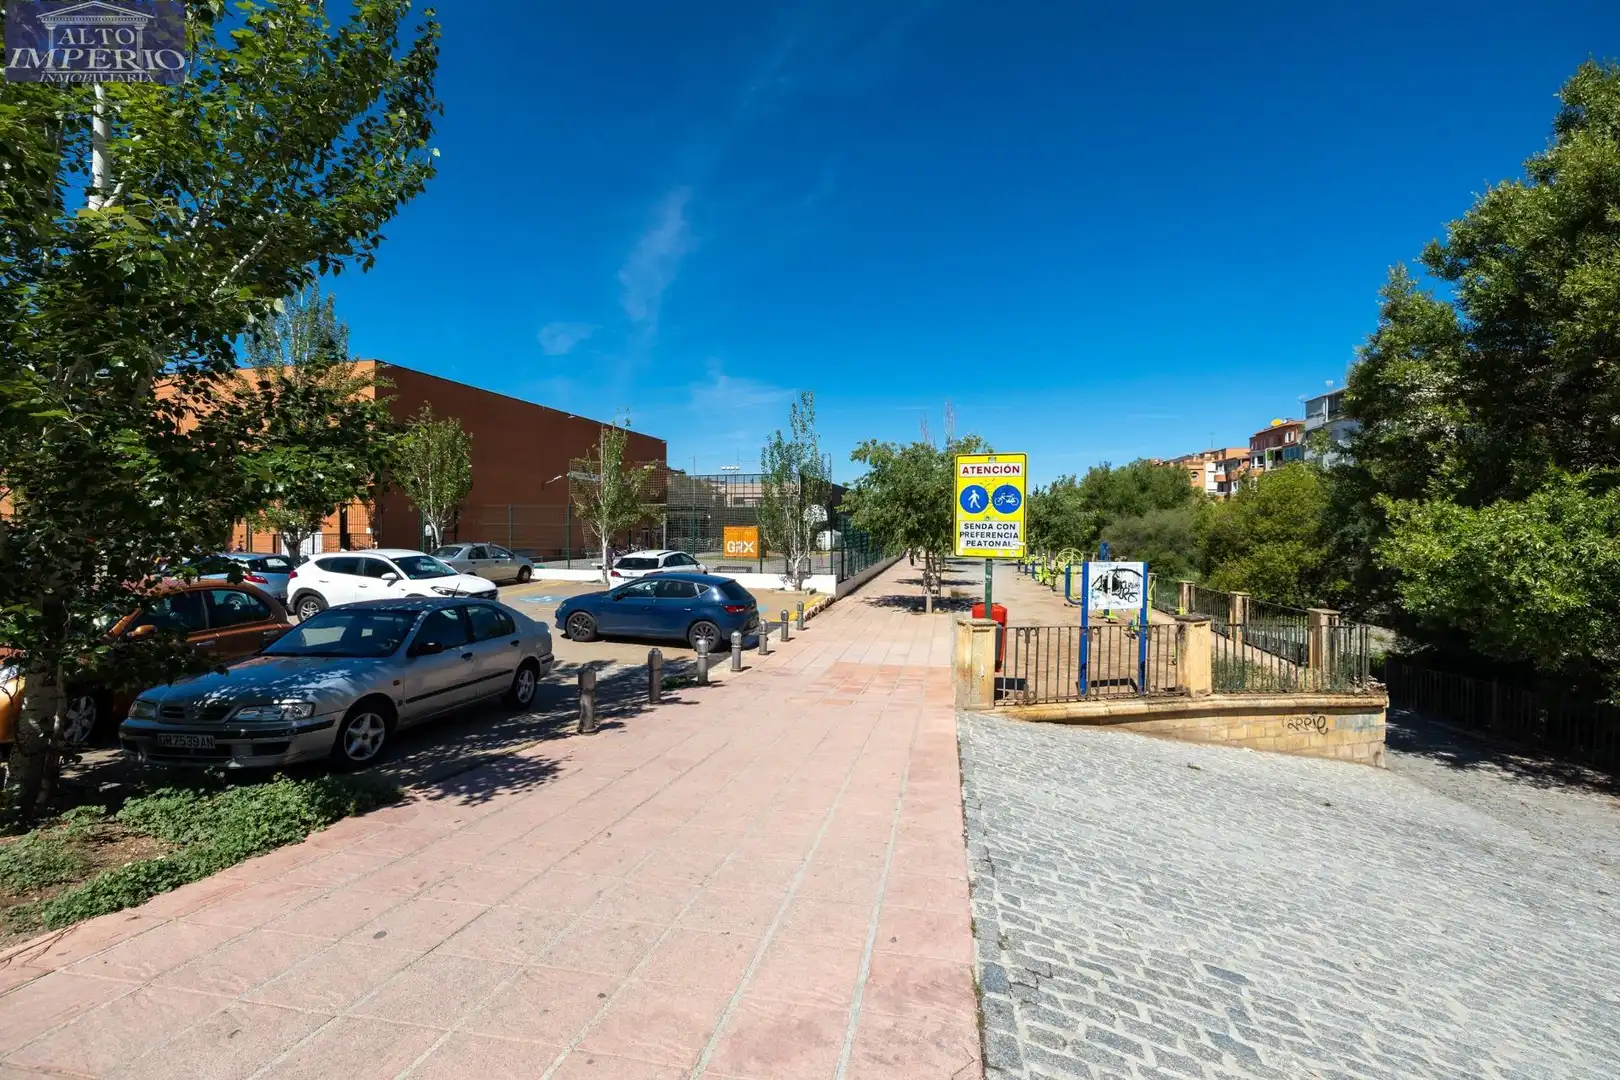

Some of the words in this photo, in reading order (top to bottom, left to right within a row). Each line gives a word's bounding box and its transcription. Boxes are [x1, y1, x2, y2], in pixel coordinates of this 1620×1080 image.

[962, 464, 1020, 474] ATENCIÓN
[959, 531, 1019, 539] PREFERENCIA
[727, 540, 754, 553] GRX
